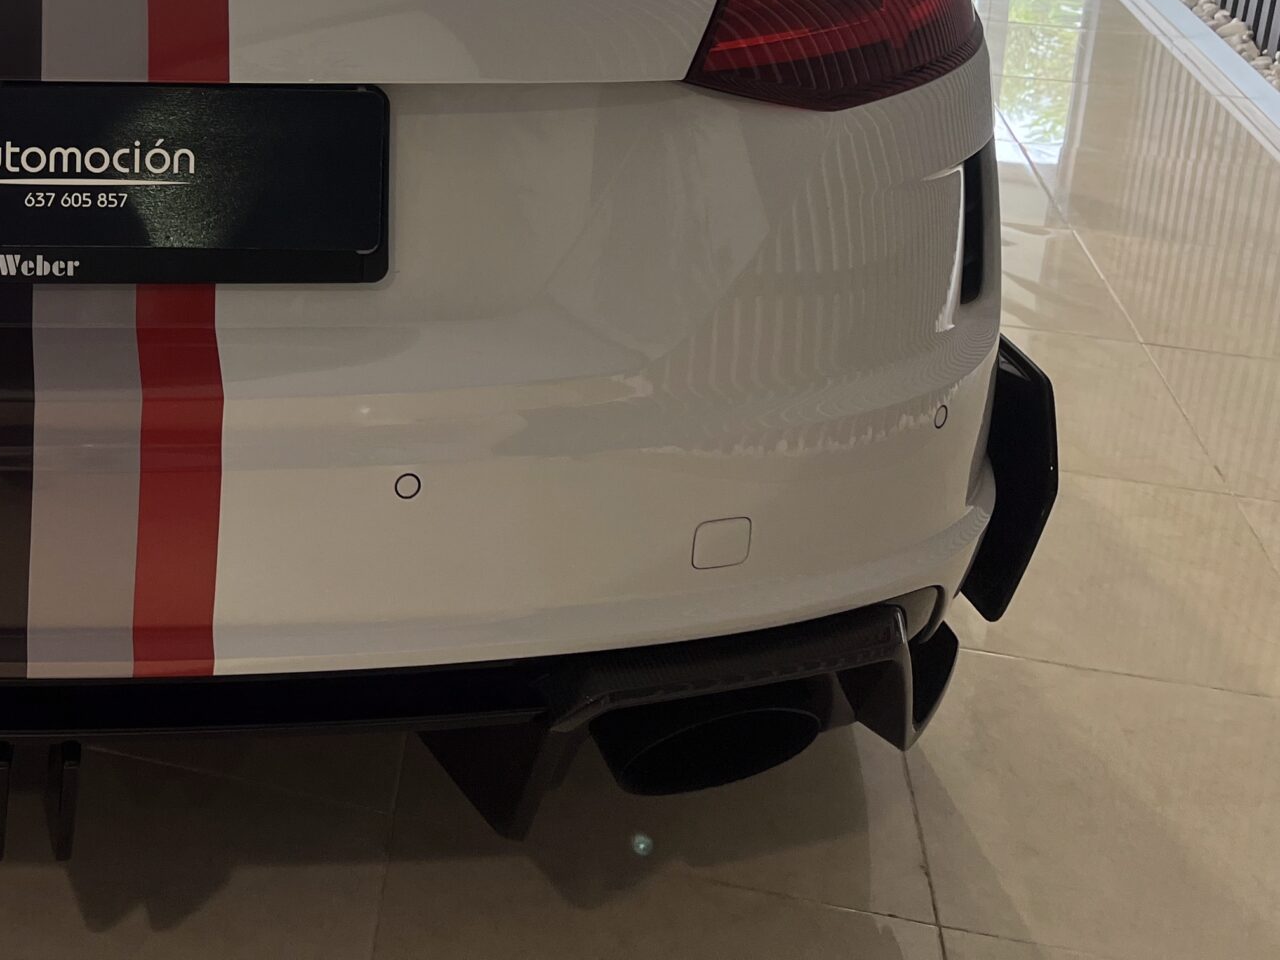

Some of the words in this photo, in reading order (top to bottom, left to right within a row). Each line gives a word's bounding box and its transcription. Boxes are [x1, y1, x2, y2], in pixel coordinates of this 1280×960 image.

[24, 192, 56, 208] 637
[60, 193, 92, 208] 605
[97, 193, 128, 208] 857
